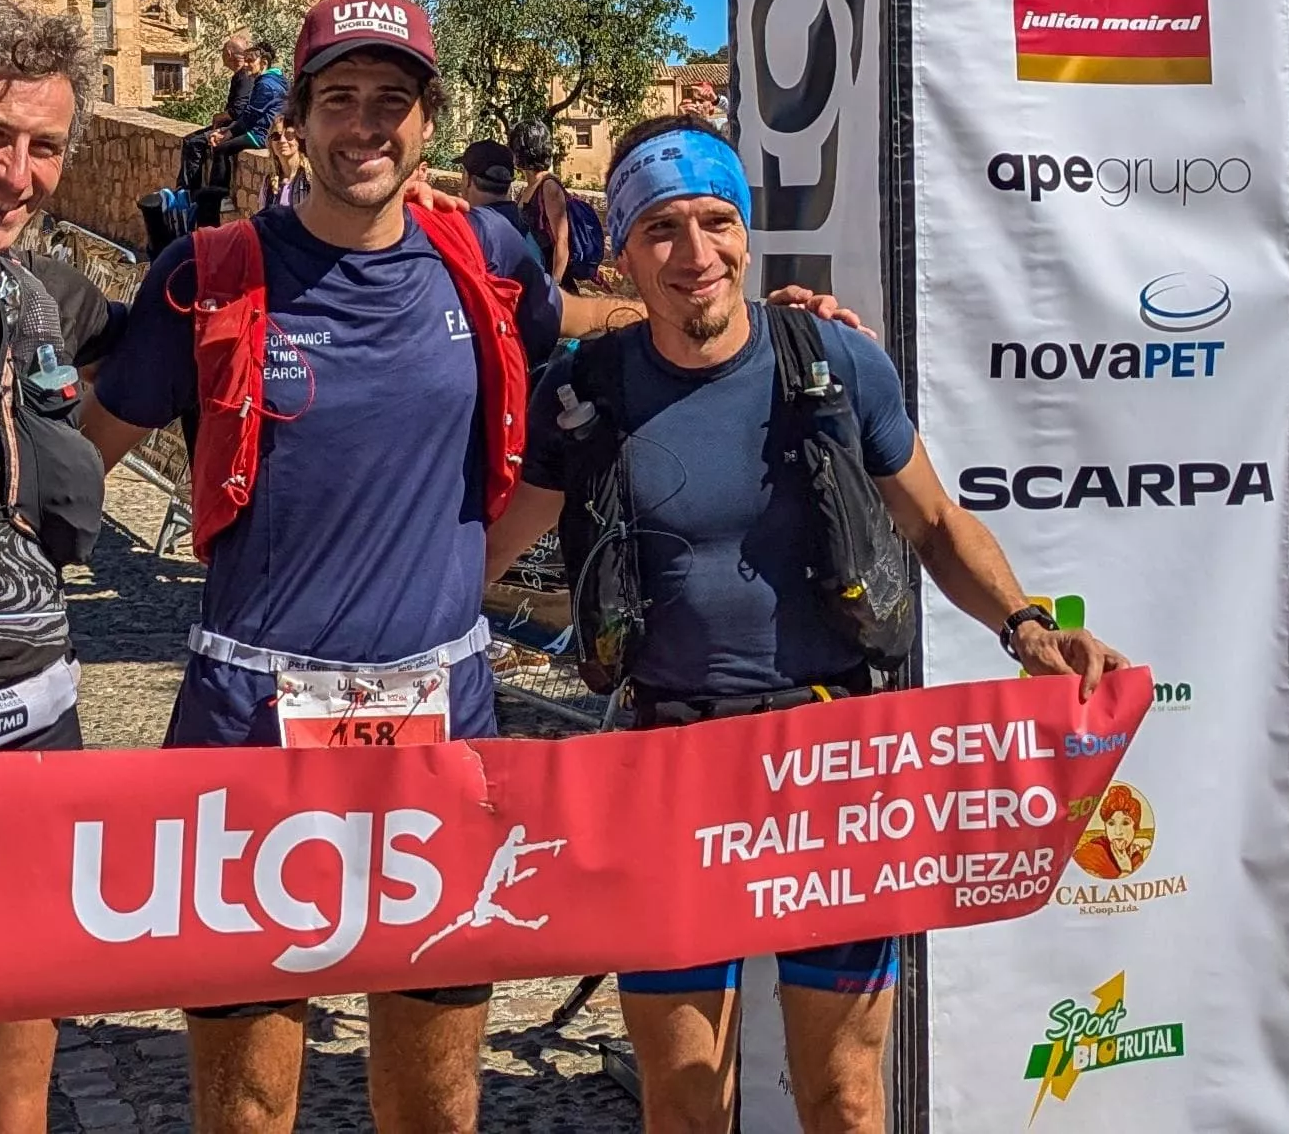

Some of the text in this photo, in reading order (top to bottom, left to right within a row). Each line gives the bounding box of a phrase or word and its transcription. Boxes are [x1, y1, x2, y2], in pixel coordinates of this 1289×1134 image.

[333, 0, 408, 25] UTMB
[337, 20, 406, 36] WORLD SERIES
[1022, 11, 1202, 31] julián mairal
[987, 153, 1252, 207] apegrupo
[445, 309, 469, 333] FA
[989, 341, 1225, 379] novaPET
[958, 463, 1274, 512] SCARPA
[762, 732, 923, 792] VUELTA
[929, 720, 1055, 766] SEVIL
[694, 807, 825, 868] TRAIL
[837, 791, 915, 845] RÍO
[923, 785, 1057, 833] VERO
[71, 787, 443, 973] utgs
[746, 846, 1055, 920] TRAIL ALQUEZAR
[956, 875, 1051, 909] ROSADO
[1056, 875, 1188, 905] CALANDINA
[1046, 999, 1126, 1047] Sport
